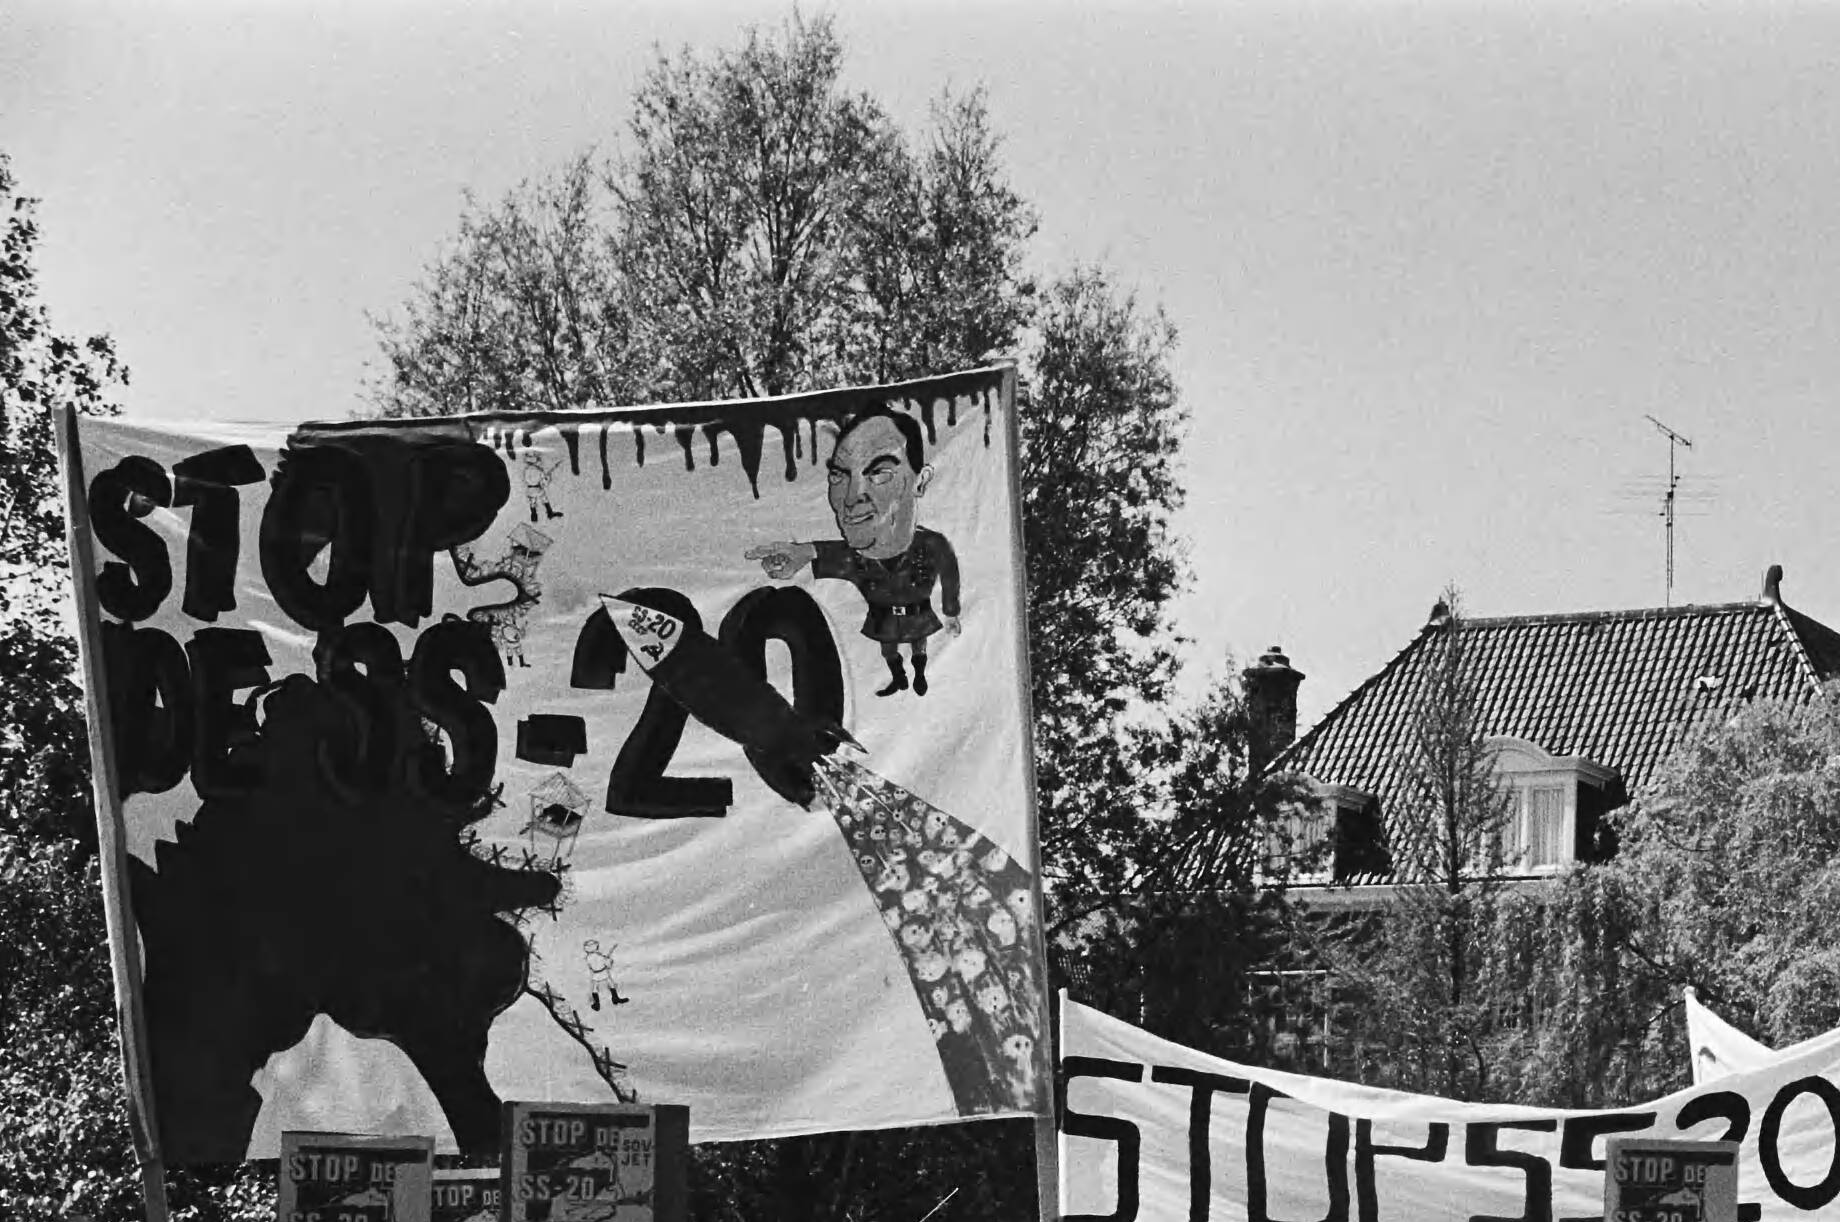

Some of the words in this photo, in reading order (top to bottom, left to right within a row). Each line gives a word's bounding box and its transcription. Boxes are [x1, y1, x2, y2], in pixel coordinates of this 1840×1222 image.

[87, 436, 511, 632] STOP
[521, 1120, 585, 1145] STOP
[597, 1128, 620, 1147] DE
[290, 1154, 359, 1182] STOP
[1615, 1157, 1674, 1182] STOP
[1684, 1165, 1706, 1183] DE
[433, 1184, 474, 1207] TOP
[520, 1175, 595, 1200] SS-20
